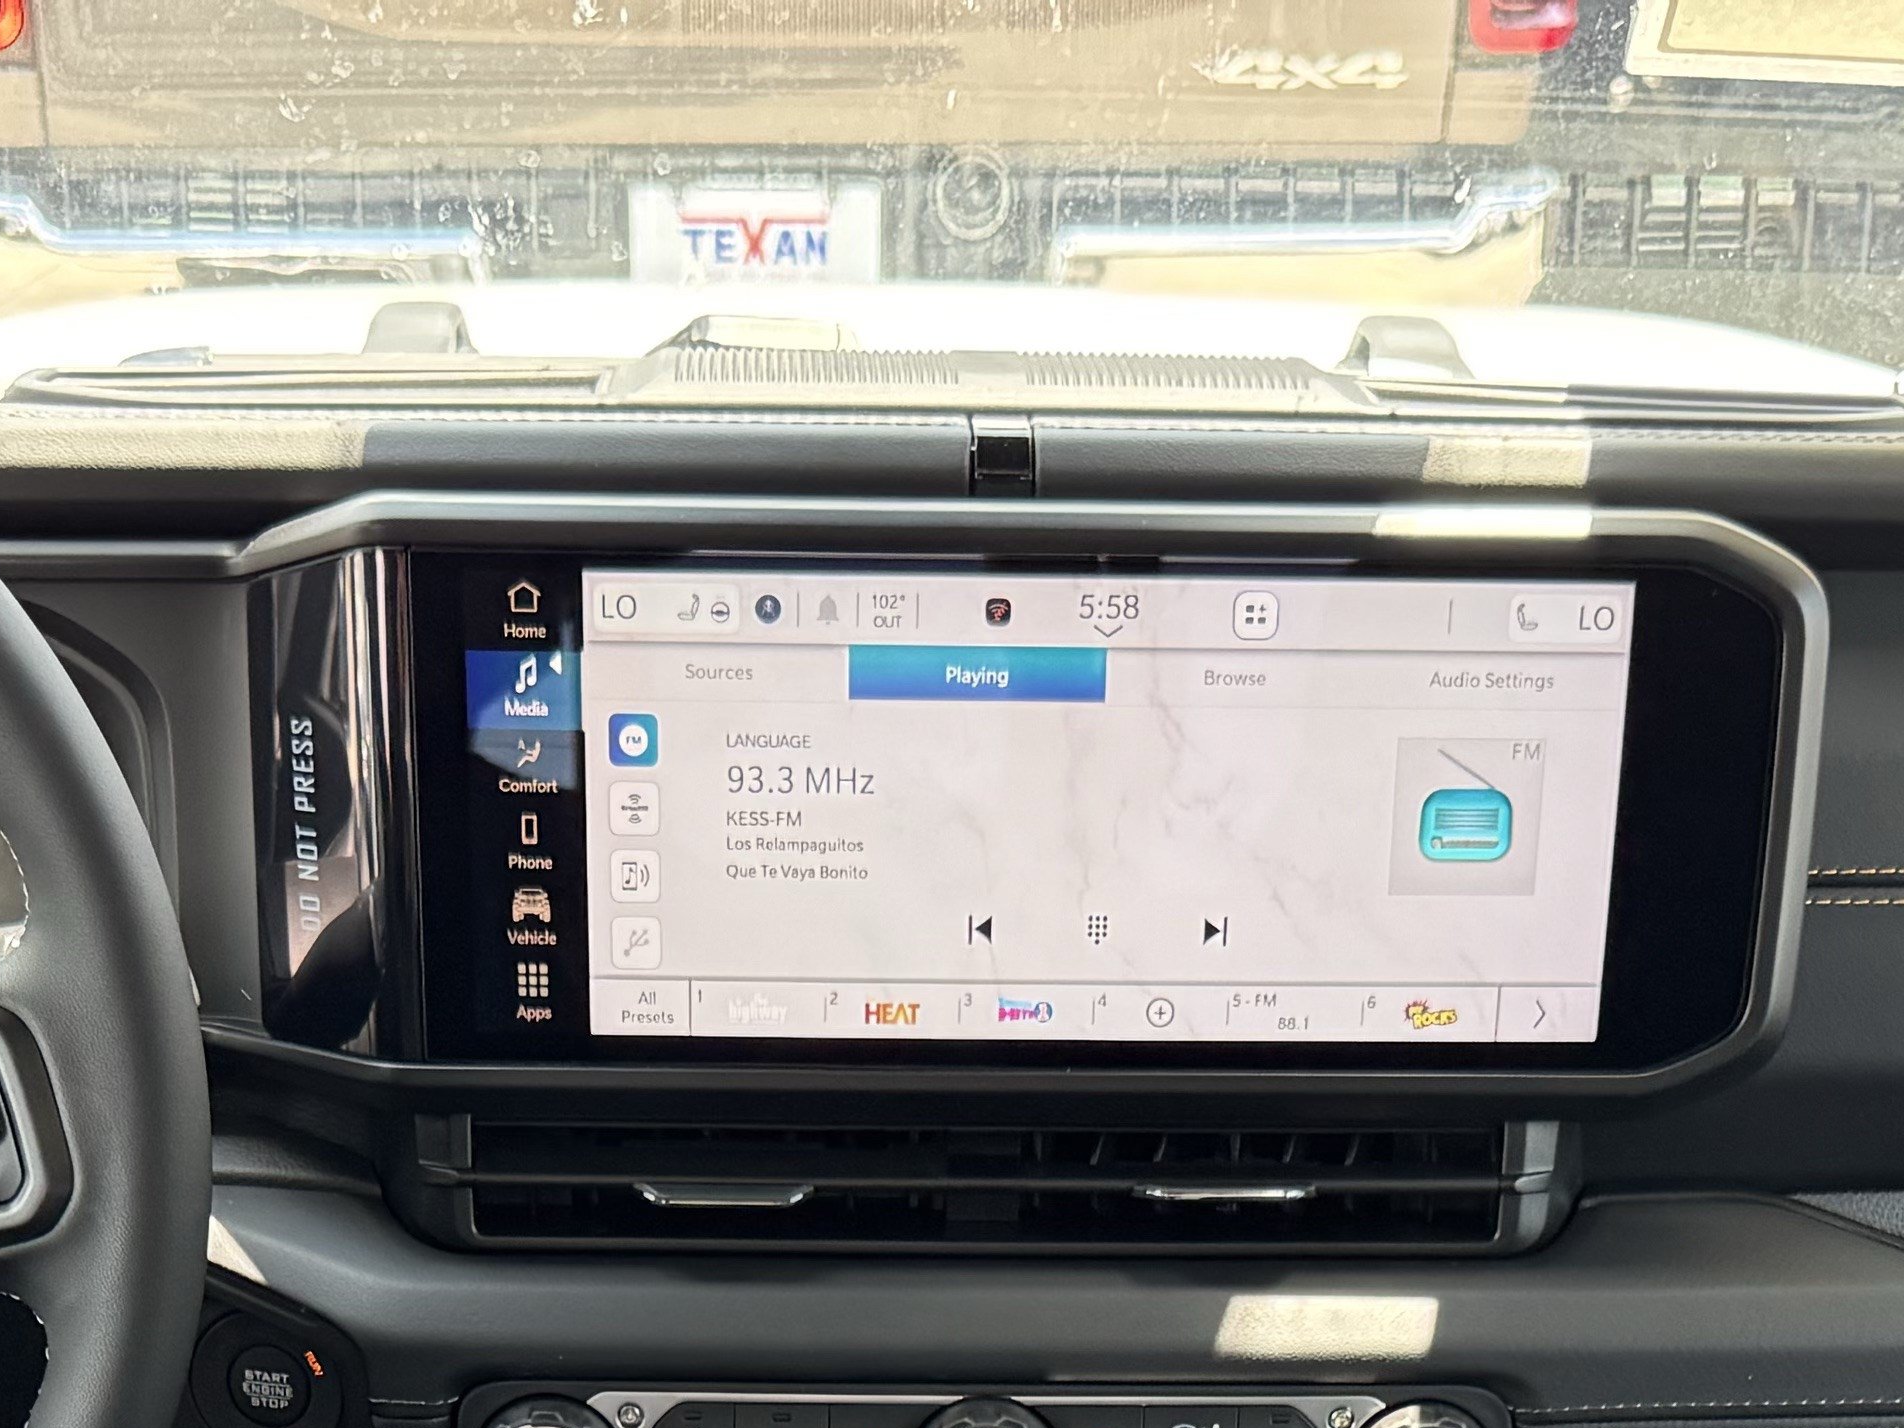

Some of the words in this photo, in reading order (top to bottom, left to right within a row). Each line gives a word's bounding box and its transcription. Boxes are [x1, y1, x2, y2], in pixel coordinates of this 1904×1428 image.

[680, 219, 827, 264] TEXAN
[601, 595, 637, 619] LO
[1079, 594, 1139, 620] 5:58
[874, 614, 902, 628] OUT
[1578, 606, 1615, 632] LO
[504, 623, 546, 639] Home
[685, 664, 753, 681] Sources
[945, 667, 1009, 689] Playing
[1204, 670, 1266, 687] Browse
[1429, 672, 1480, 689] Audio
[1485, 673, 1554, 692] Settings
[504, 700, 549, 717] Media
[726, 734, 811, 749] LANGUAGE
[1512, 743, 1541, 760] FM
[290, 716, 316, 813] PRESS
[498, 779, 558, 795] Comfort
[728, 766, 793, 793] 93.3
[806, 767, 874, 794] MHz
[726, 811, 802, 826] KESS-FM
[296, 823, 319, 881] NOT
[726, 837, 752, 851] Los
[757, 837, 864, 854] Relampaguitos
[508, 854, 553, 870] Phone
[726, 865, 757, 879] Que
[761, 865, 777, 878] Te
[781, 865, 815, 882] Vaya
[821, 865, 868, 880] Bonito
[507, 929, 557, 946] Vehicle
[639, 991, 656, 1005] All
[830, 992, 838, 1006] 2
[964, 993, 972, 1007] 3
[1098, 993, 1107, 1007] 4
[1233, 994, 1241, 1007] 5
[1254, 994, 1277, 1007] FM
[1367, 996, 1376, 1009] 6
[516, 1005, 552, 1023] Apps
[621, 1010, 674, 1024] Presets
[865, 1003, 920, 1025] HEAT
[1278, 1017, 1309, 1030] 88.1
[245, 1369, 289, 1384] START
[243, 1381, 293, 1398] ENGINE
[251, 1397, 288, 1409] STOP
